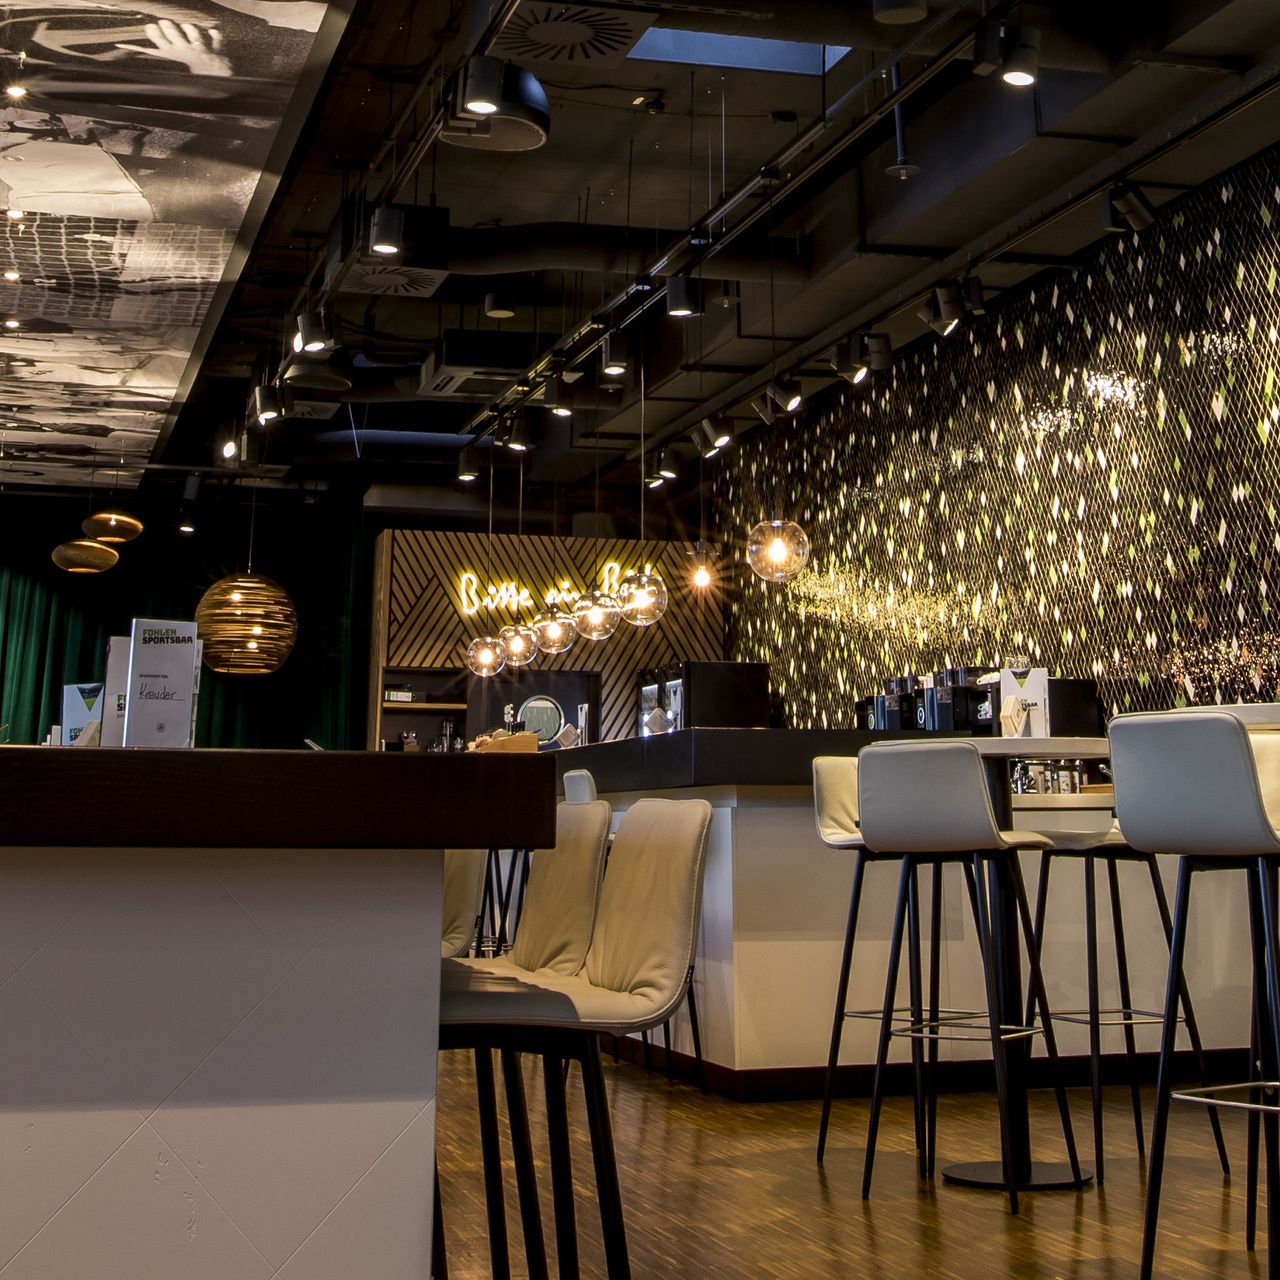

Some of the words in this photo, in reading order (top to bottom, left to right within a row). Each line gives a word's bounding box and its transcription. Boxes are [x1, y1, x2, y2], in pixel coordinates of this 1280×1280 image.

[460, 572, 534, 615] Bitte
[544, 580, 580, 605] ein
[143, 629, 176, 637] FOHLEN
[142, 636, 194, 645] SPORTSBAR
